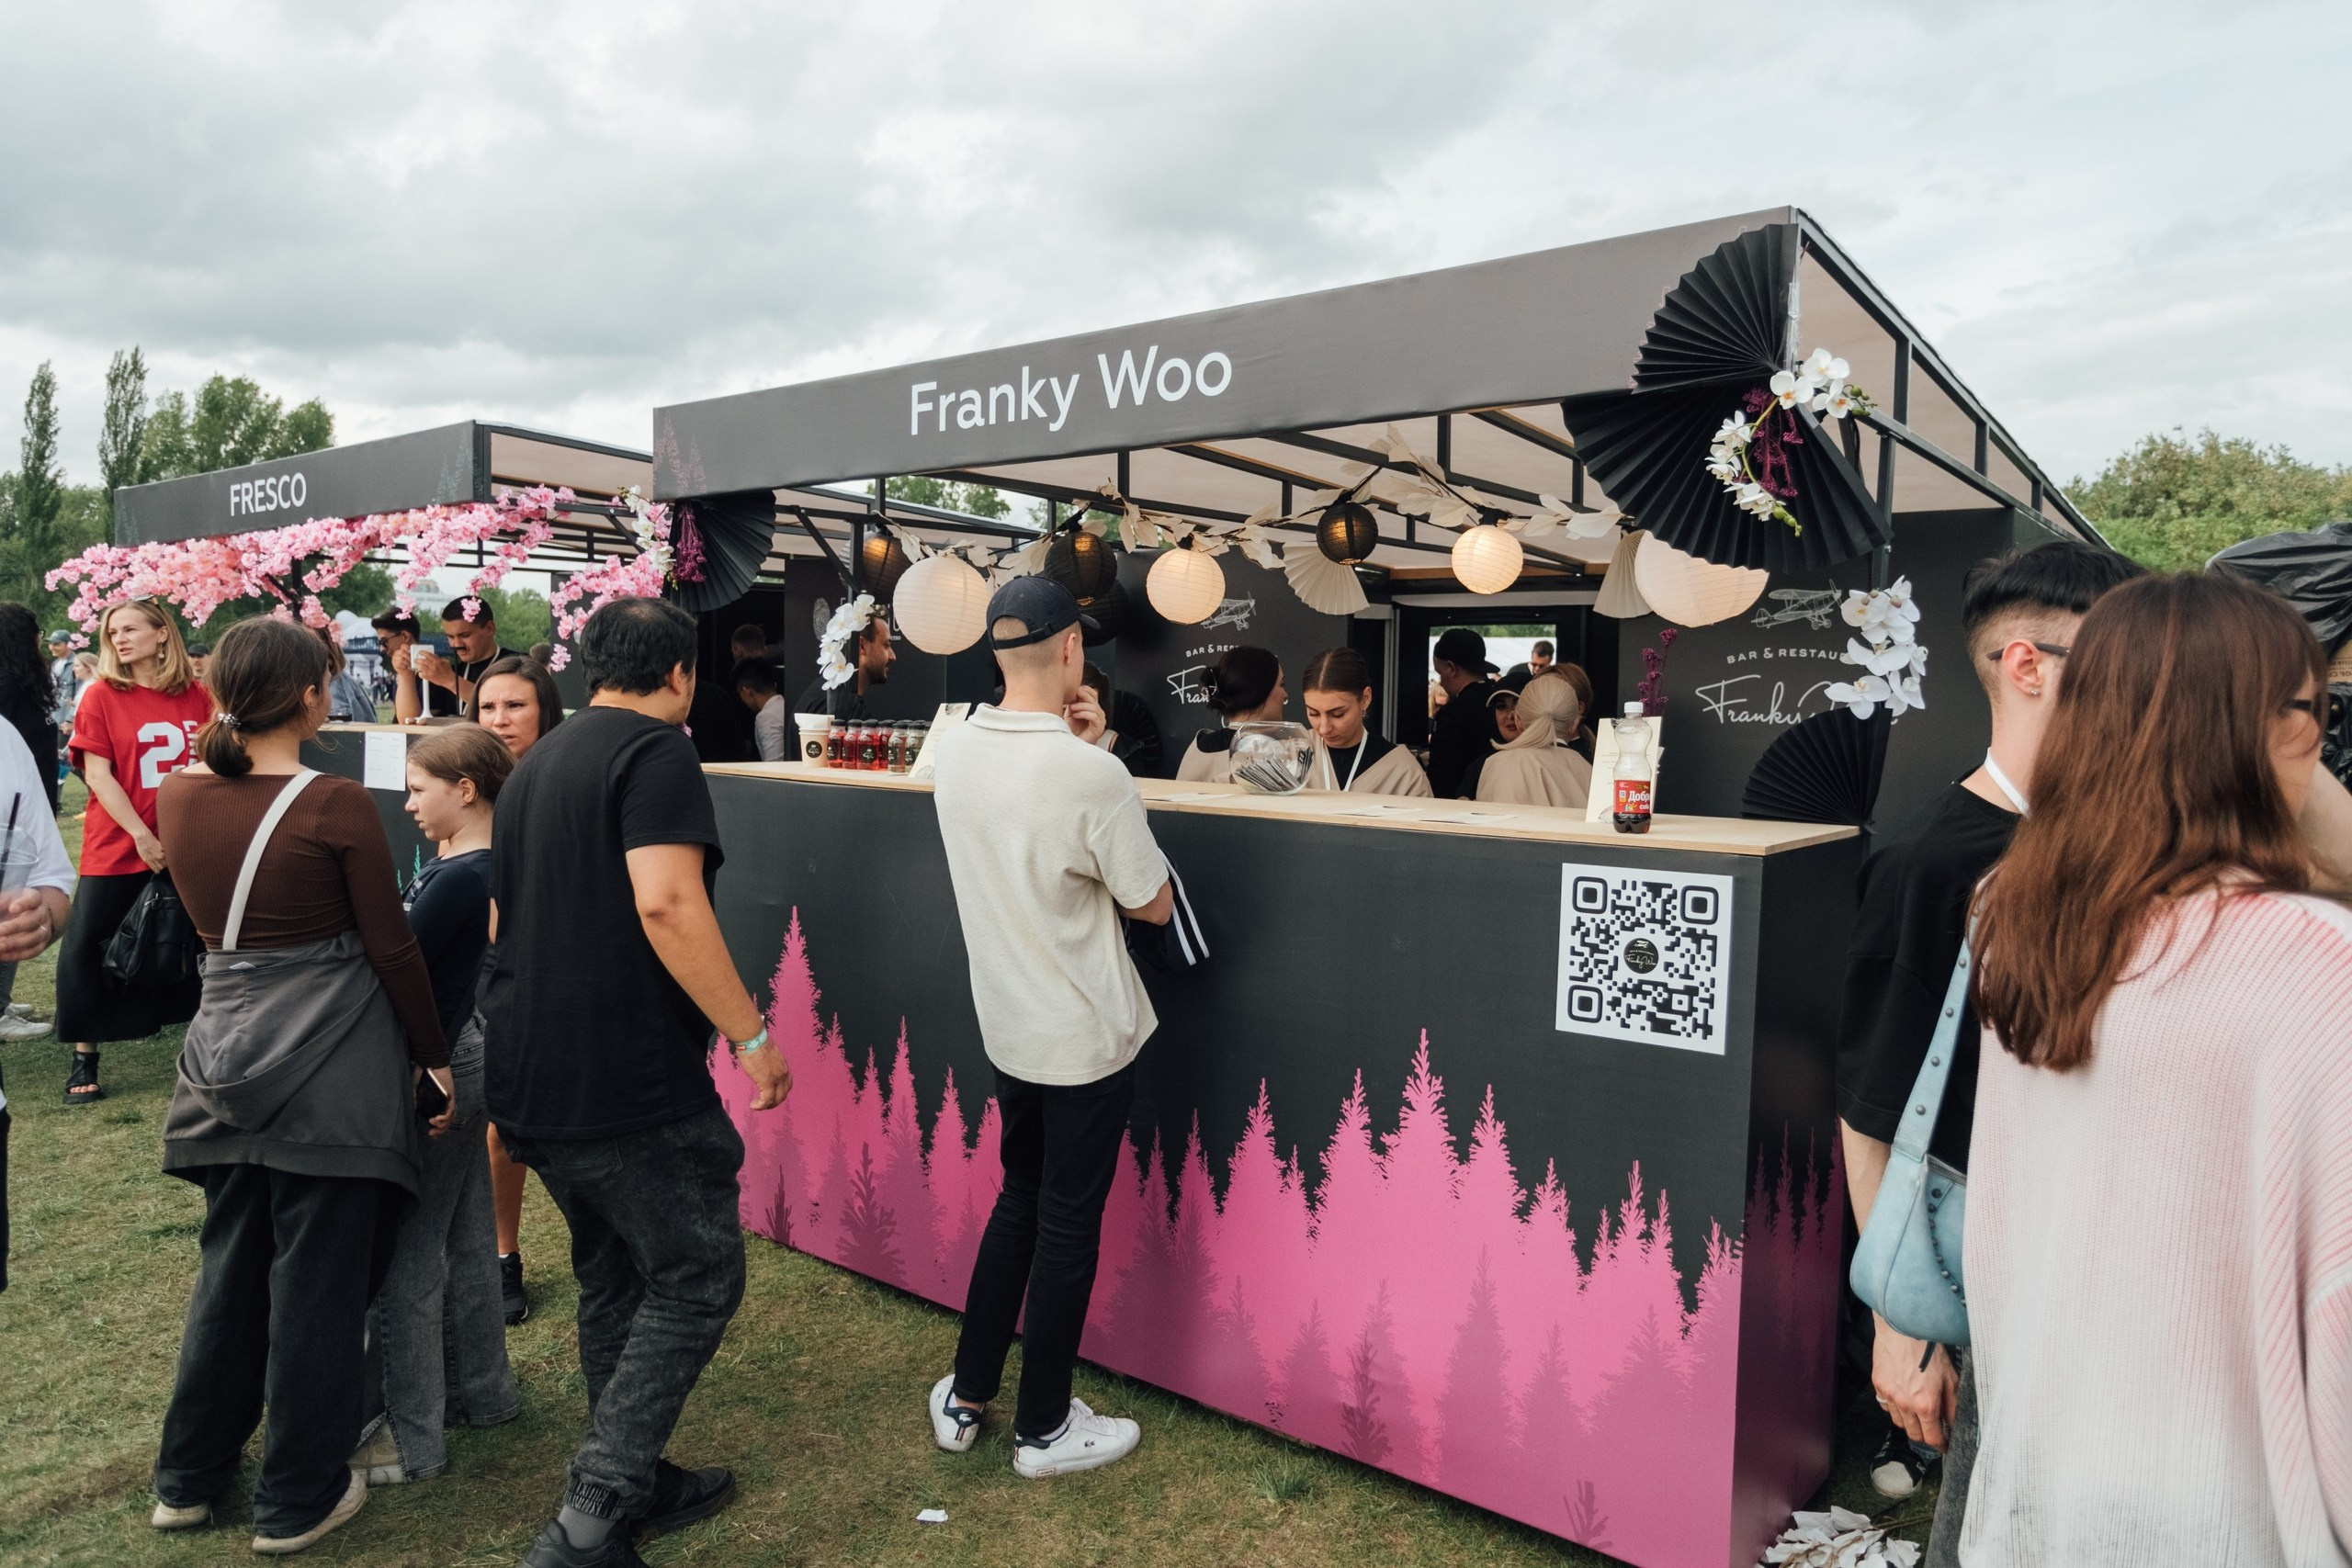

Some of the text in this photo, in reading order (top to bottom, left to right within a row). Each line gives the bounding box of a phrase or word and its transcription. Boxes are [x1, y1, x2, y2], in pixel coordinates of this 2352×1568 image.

[911, 345, 1232, 435] Franky Woo
[231, 472, 307, 516] FRESCO
[1185, 647, 1204, 658] BAR
[1207, 644, 1215, 653] &
[1727, 650, 1758, 664] BAR
[1763, 648, 1774, 659] &
[1628, 790, 1650, 803] Добр
